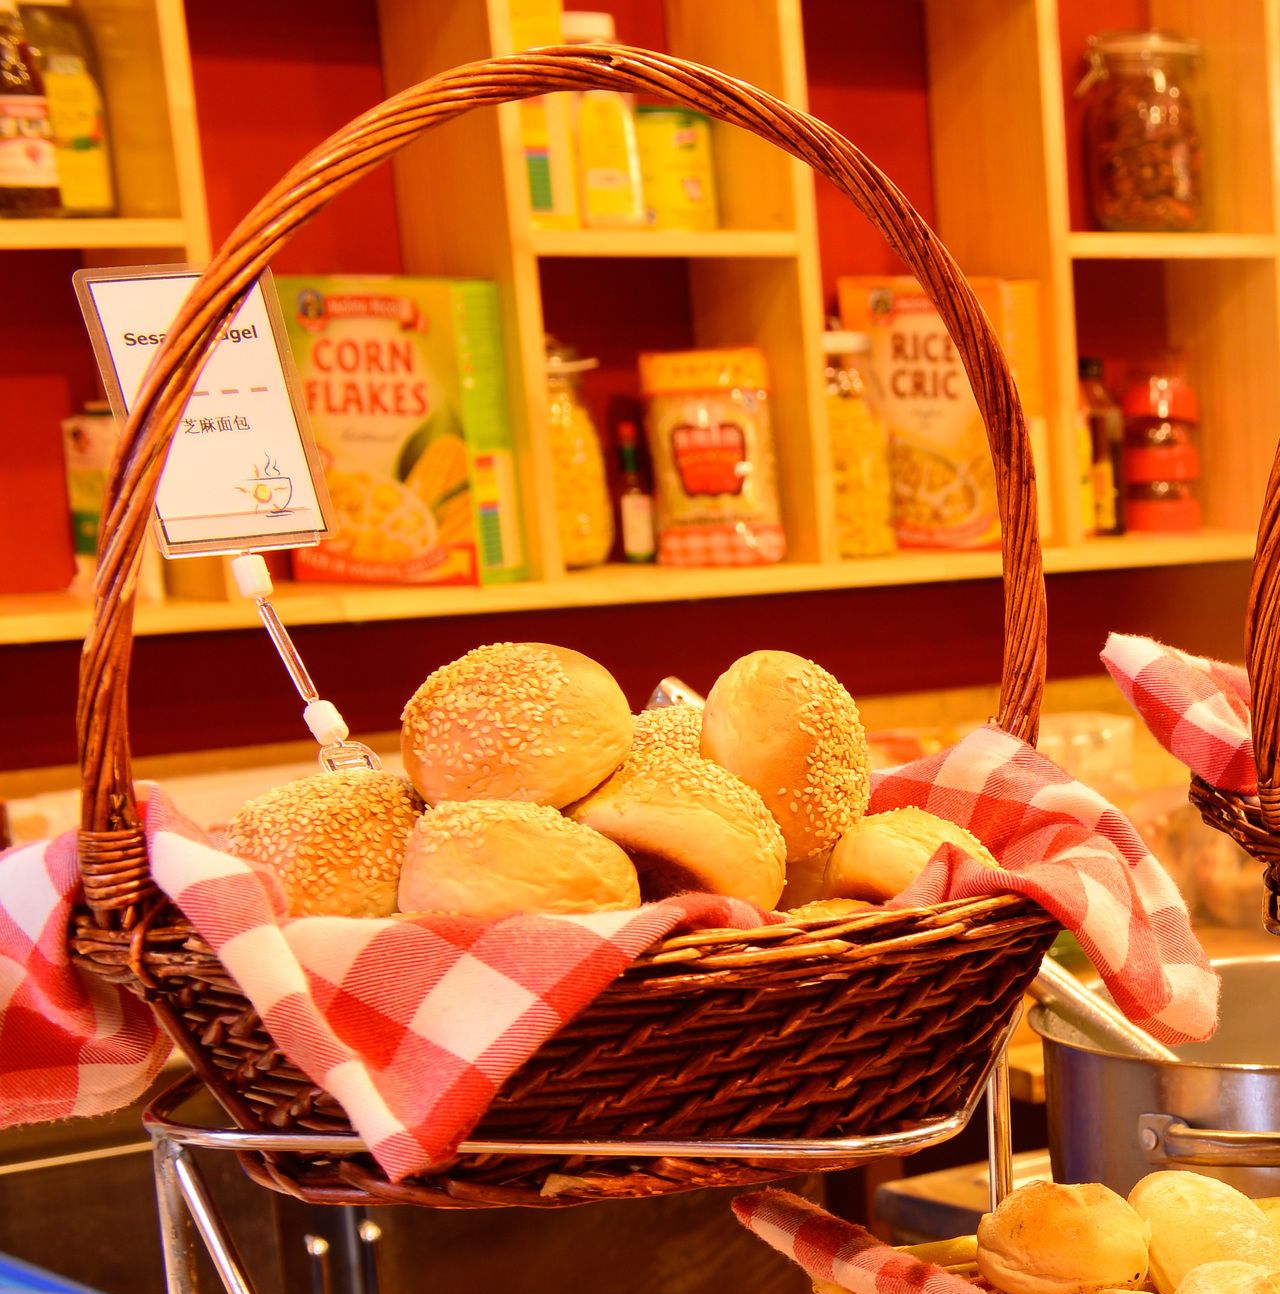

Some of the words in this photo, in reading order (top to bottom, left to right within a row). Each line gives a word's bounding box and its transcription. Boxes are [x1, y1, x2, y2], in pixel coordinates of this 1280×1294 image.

[123, 331, 167, 346] Sesa
[219, 325, 259, 343] agel
[311, 337, 415, 374] CORN
[304, 381, 429, 417] FLAKES
[183, 415, 251, 435] 芝麻面包
